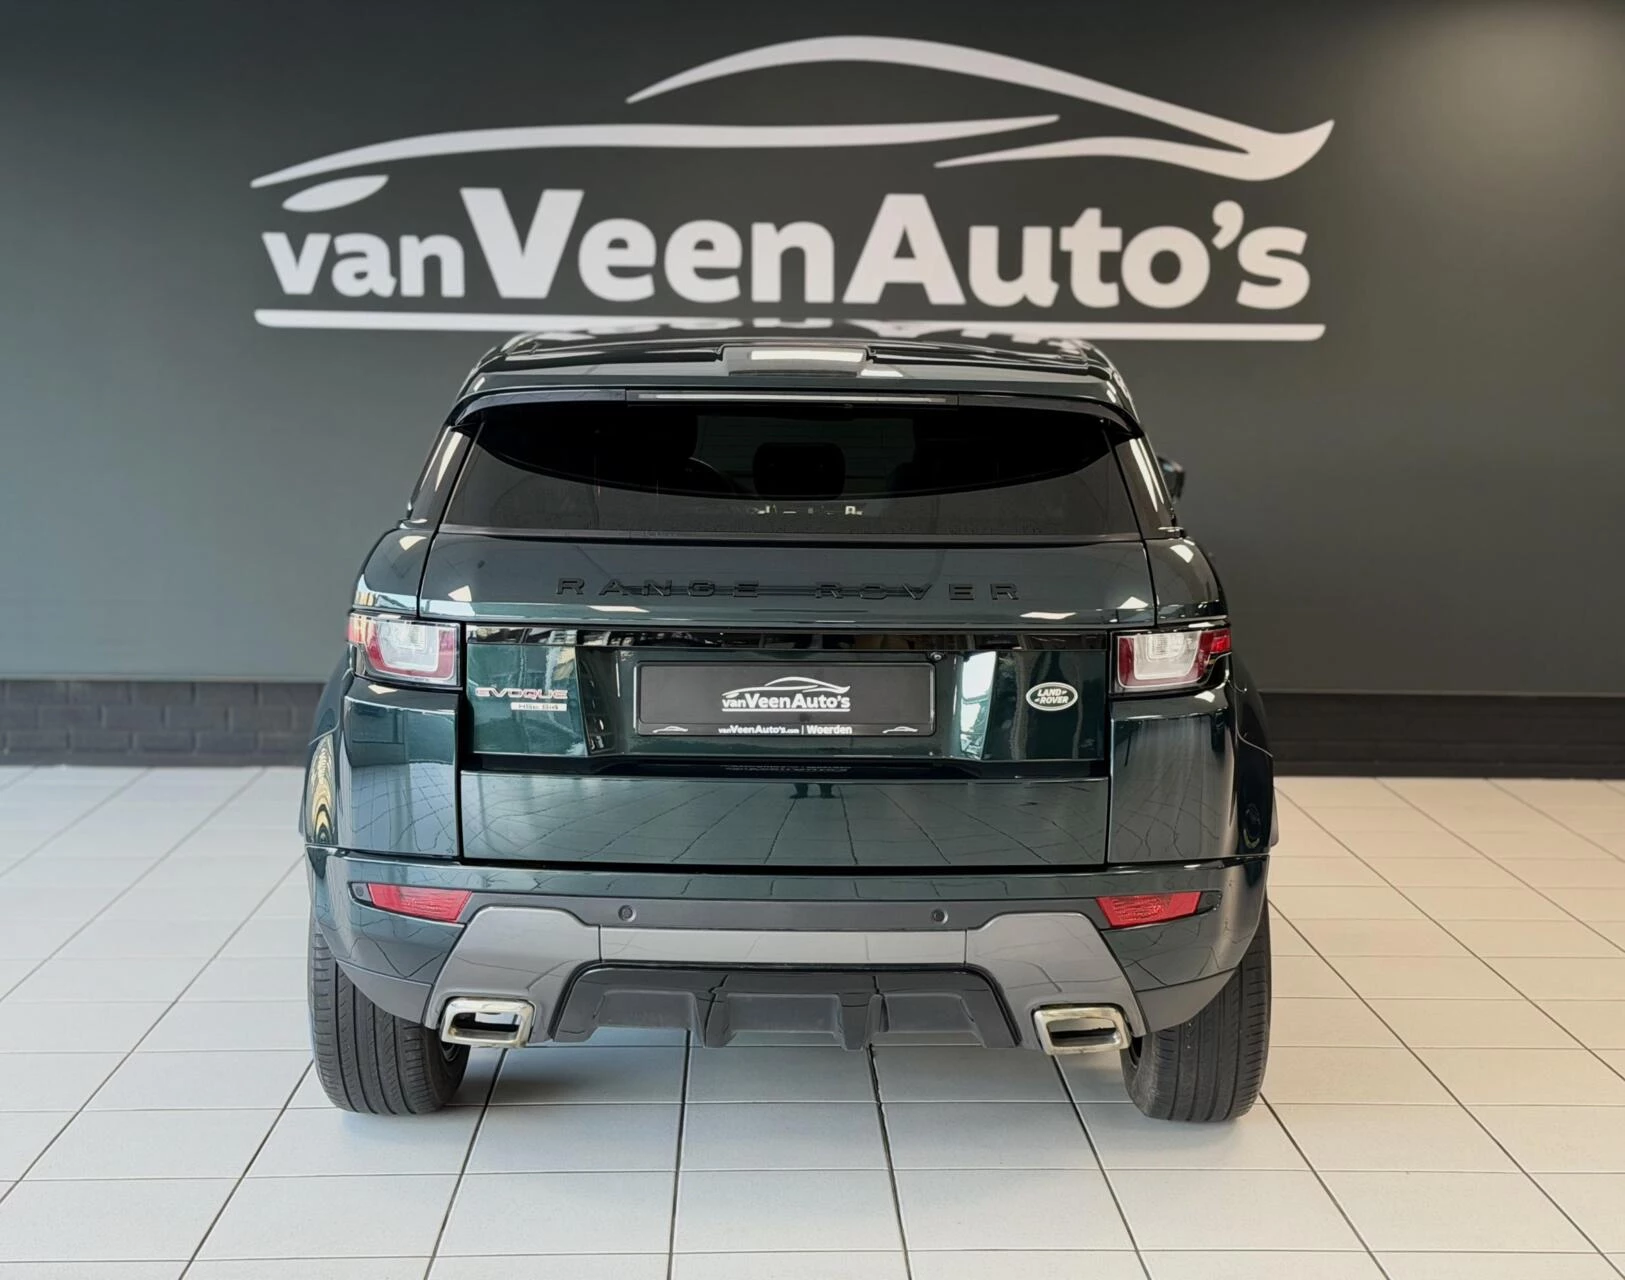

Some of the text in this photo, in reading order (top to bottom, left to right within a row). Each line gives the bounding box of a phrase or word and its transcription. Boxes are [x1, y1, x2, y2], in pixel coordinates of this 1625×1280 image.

[556, 577, 1020, 601] RANGE ROVER
[475, 687, 568, 700] EVOQUE
[1037, 688, 1062, 696] LAND
[1039, 696, 1069, 704] ROVER
[806, 725, 853, 735] Woerden
